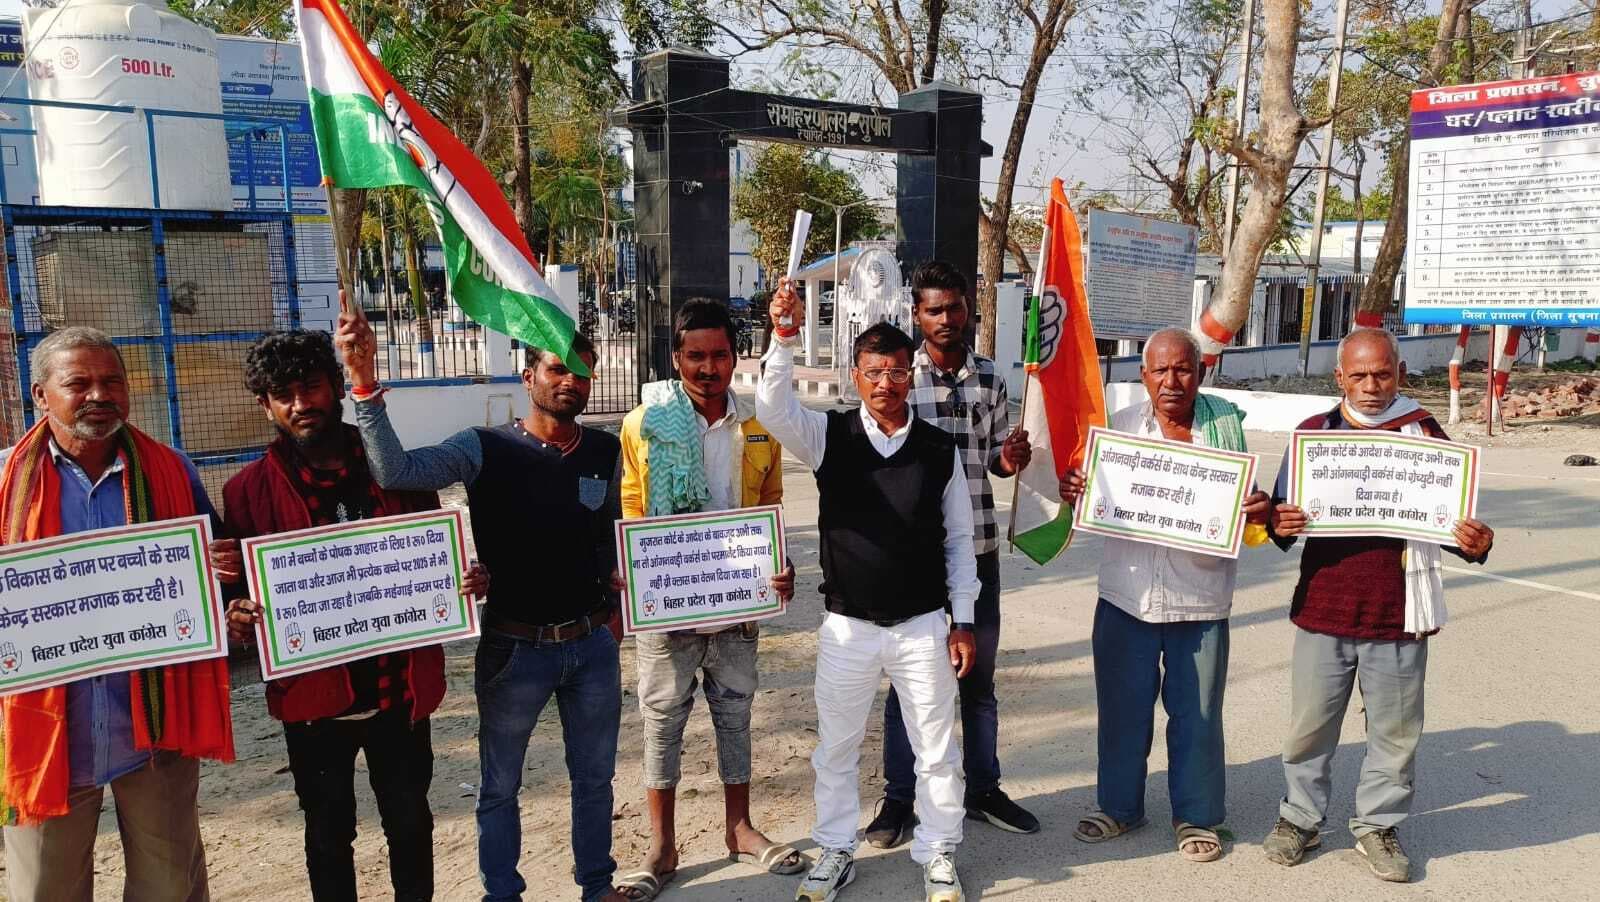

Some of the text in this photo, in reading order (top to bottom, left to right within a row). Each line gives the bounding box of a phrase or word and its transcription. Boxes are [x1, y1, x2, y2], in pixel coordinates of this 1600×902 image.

[122, 58, 176, 78] 500 Ltr.
[1428, 90, 1478, 104] जिला
[1462, 310, 1486, 320] जिला
[1307, 443, 1329, 462] सुप्रीम
[1348, 444, 1358, 457] के
[1358, 444, 1382, 457] आदेश
[1384, 445, 1393, 458] के
[1394, 449, 1424, 466] बावजूद
[1424, 452, 1443, 464] अभी
[1444, 456, 1460, 466] तक
[1163, 456, 1172, 473] के
[1173, 462, 1188, 476] साथ
[1210, 469, 1238, 484] सरकार
[1312, 465, 1329, 480] सभी
[1395, 468, 1406, 482] को
[1131, 483, 1156, 497] मजाक
[1157, 486, 1171, 500] कर
[1171, 486, 1184, 504] रही
[1356, 488, 1372, 500] दिया
[1374, 491, 1390, 500] गया
[1114, 506, 1202, 532] बिहार प्रदेश युवा कांग्रेस
[1330, 504, 1427, 521] बिहार प्रदेश युवा कांग्रेस
[678, 531, 684, 543] के
[686, 530, 704, 543] आदेश
[704, 528, 712, 540] के
[736, 524, 749, 537] अभी
[751, 526, 762, 534] तक
[272, 556, 286, 570] 2017
[288, 552, 296, 567] में
[298, 548, 318, 564] बच्चों
[319, 546, 328, 560] के
[354, 541, 378, 555] आहार
[379, 537, 388, 551] के
[389, 534, 406, 550] लिए
[426, 530, 444, 543] दिया
[737, 545, 752, 558] किया
[754, 546, 766, 556] गया
[5, 568, 50, 592] विकास
[53, 559, 67, 580] के
[70, 559, 96, 578] नाम
[98, 555, 117, 572] पर
[118, 546, 148, 569] बच्चों
[150, 544, 162, 565] के
[165, 545, 190, 562] साथ
[274, 581, 296, 594] जाता
[298, 580, 308, 590] था
[309, 572, 325, 588] और
[326, 572, 345, 586] आज
[347, 566, 356, 581] भी
[358, 563, 382, 581] प्रत्येक
[384, 560, 400, 574] बच्चे
[402, 560, 412, 572] पर
[438, 551, 448, 566] भी
[716, 568, 730, 581] दिया
[732, 570, 740, 580] जा
[741, 568, 752, 579] रहा
[30, 599, 78, 622] सरकार
[80, 590, 120, 612] मजाक
[122, 586, 145, 604] कर
[145, 578, 166, 602] रही
[298, 600, 318, 616] दिया
[318, 598, 330, 611] जा
[331, 596, 344, 610] रहा
[358, 586, 382, 604] जबकि
[414, 580, 432, 593] चरम
[433, 578, 444, 590] पर
[664, 587, 752, 610] बिहार प्रदेश युवा कांग्रेस
[313, 606, 427, 643] बिहार प्रदेश युवा कांग्रेस
[32, 622, 168, 662] बिहार प्रदेश युवा कांग्रेस
